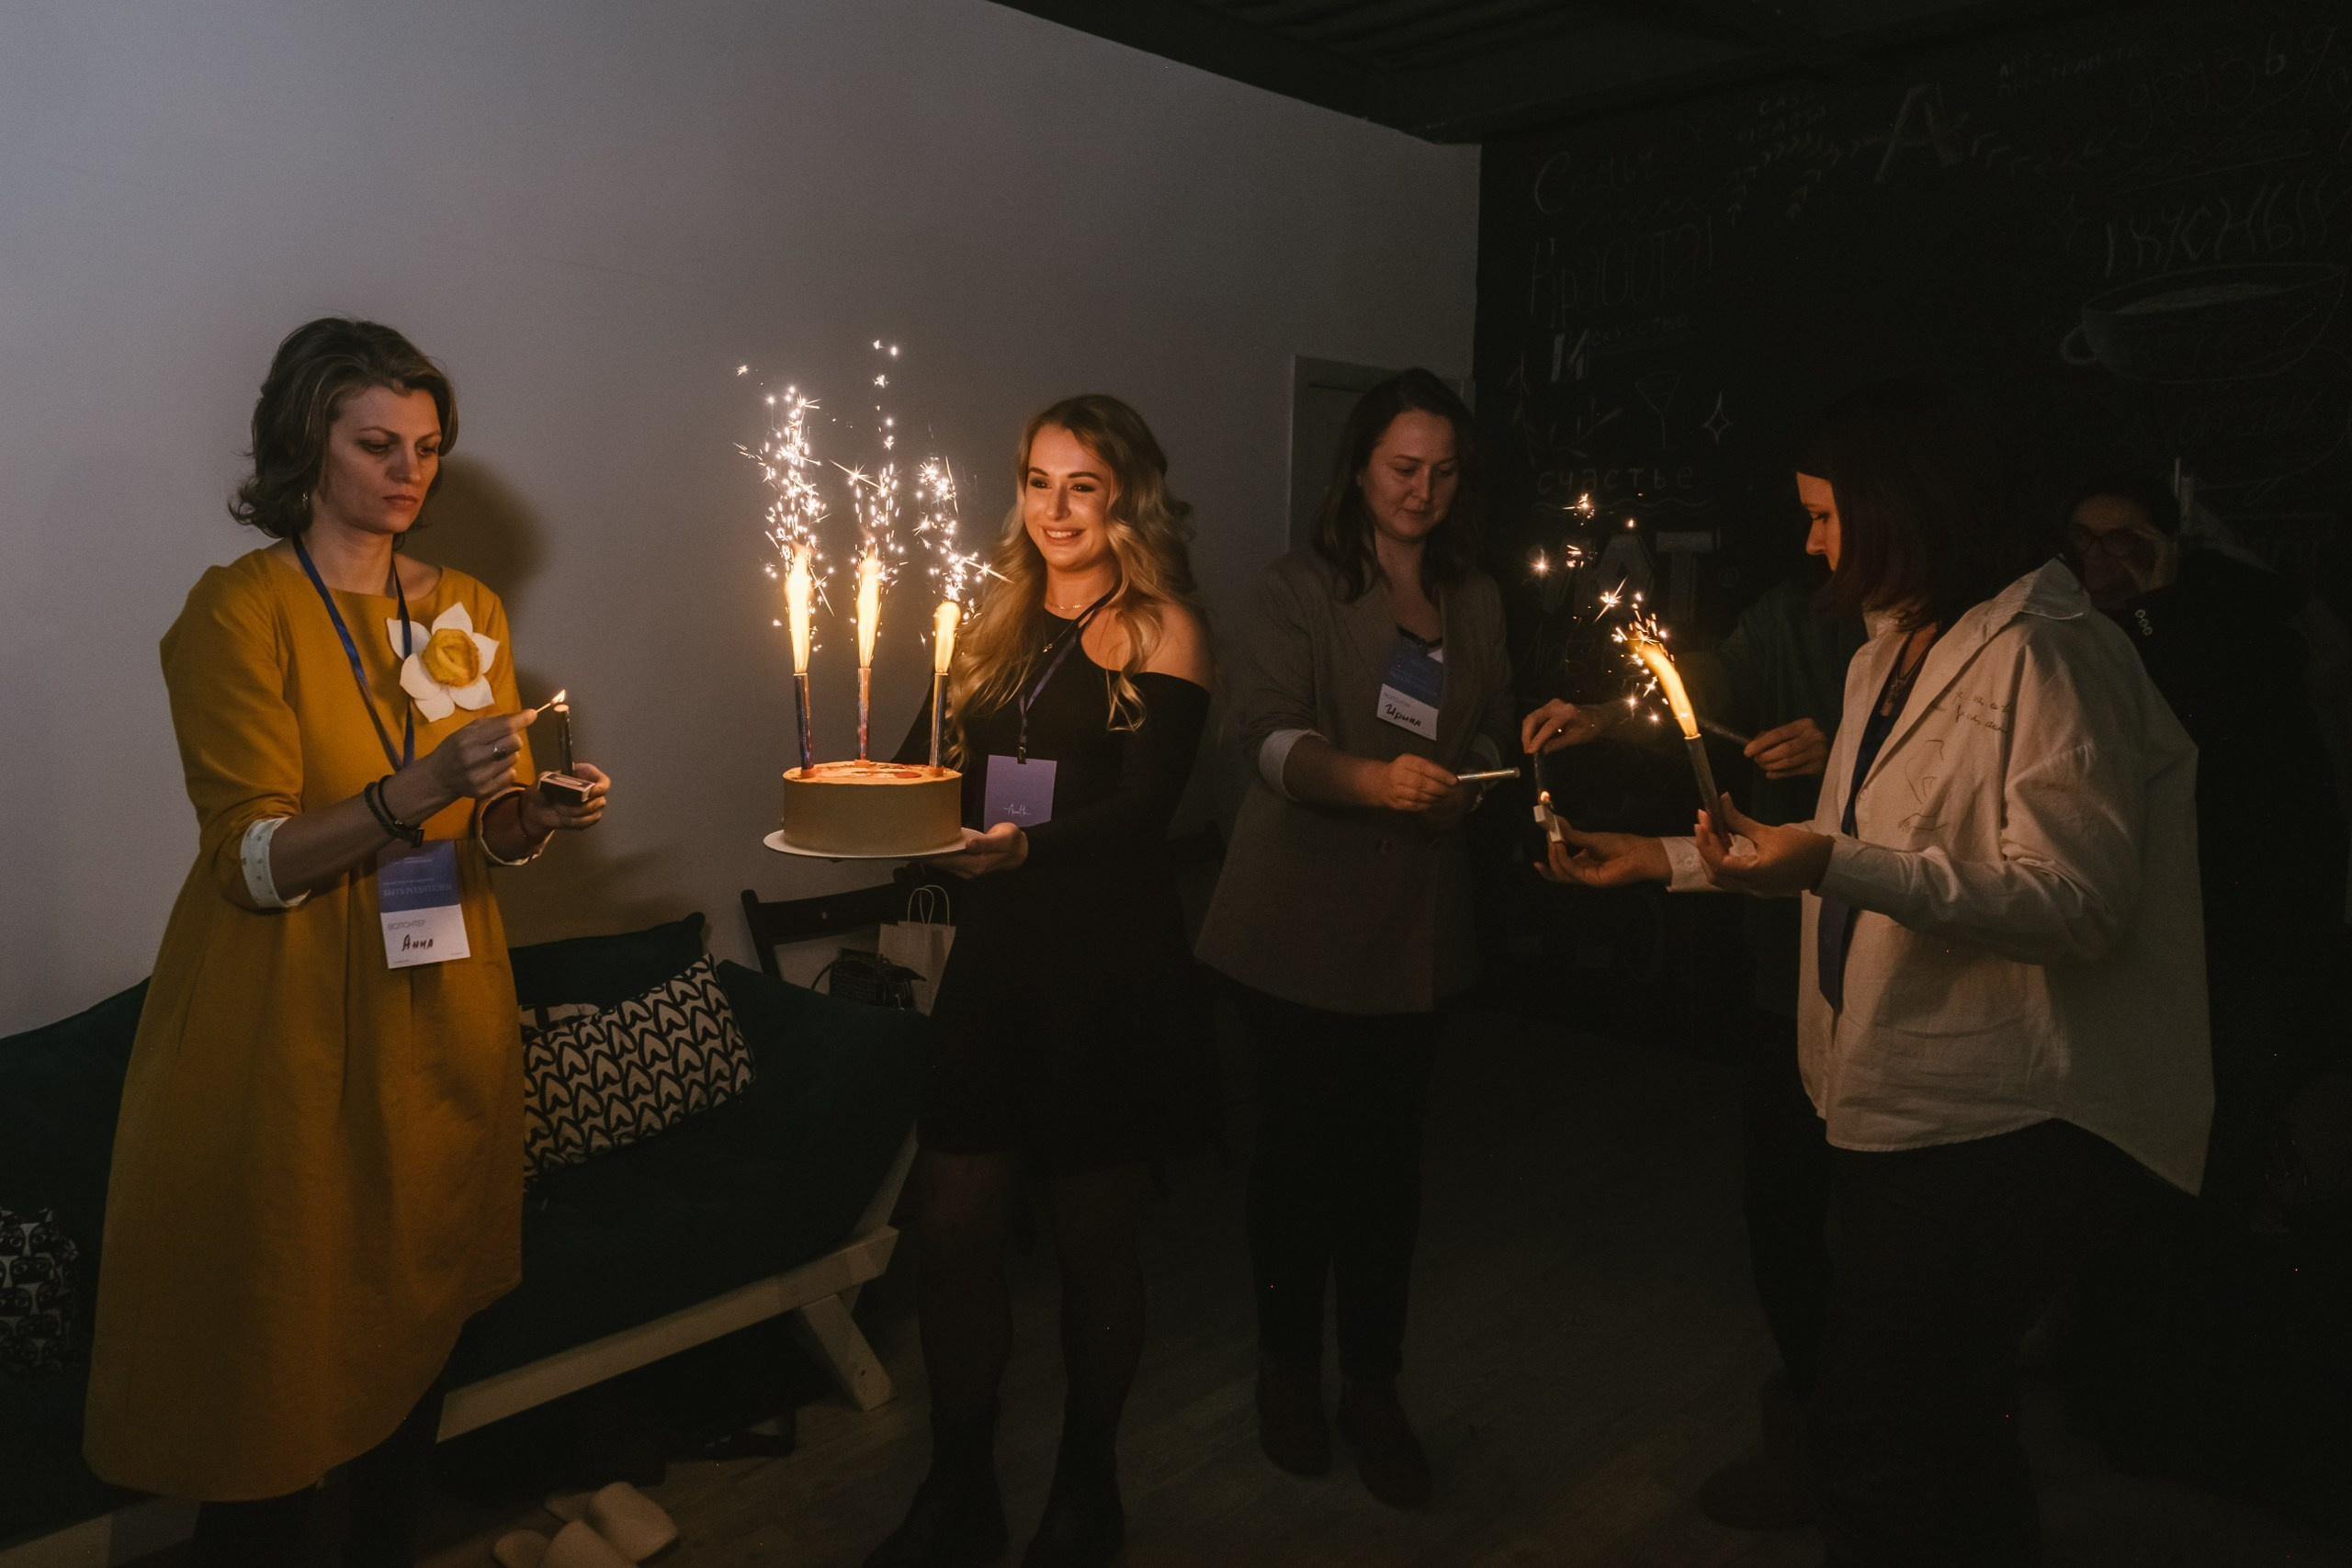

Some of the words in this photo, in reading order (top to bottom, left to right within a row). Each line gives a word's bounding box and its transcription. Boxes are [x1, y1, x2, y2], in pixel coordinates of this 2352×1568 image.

[1536, 467, 1694, 496] счастье
[1385, 704, 1421, 728] Ирина
[401, 934, 435, 952] Анна
